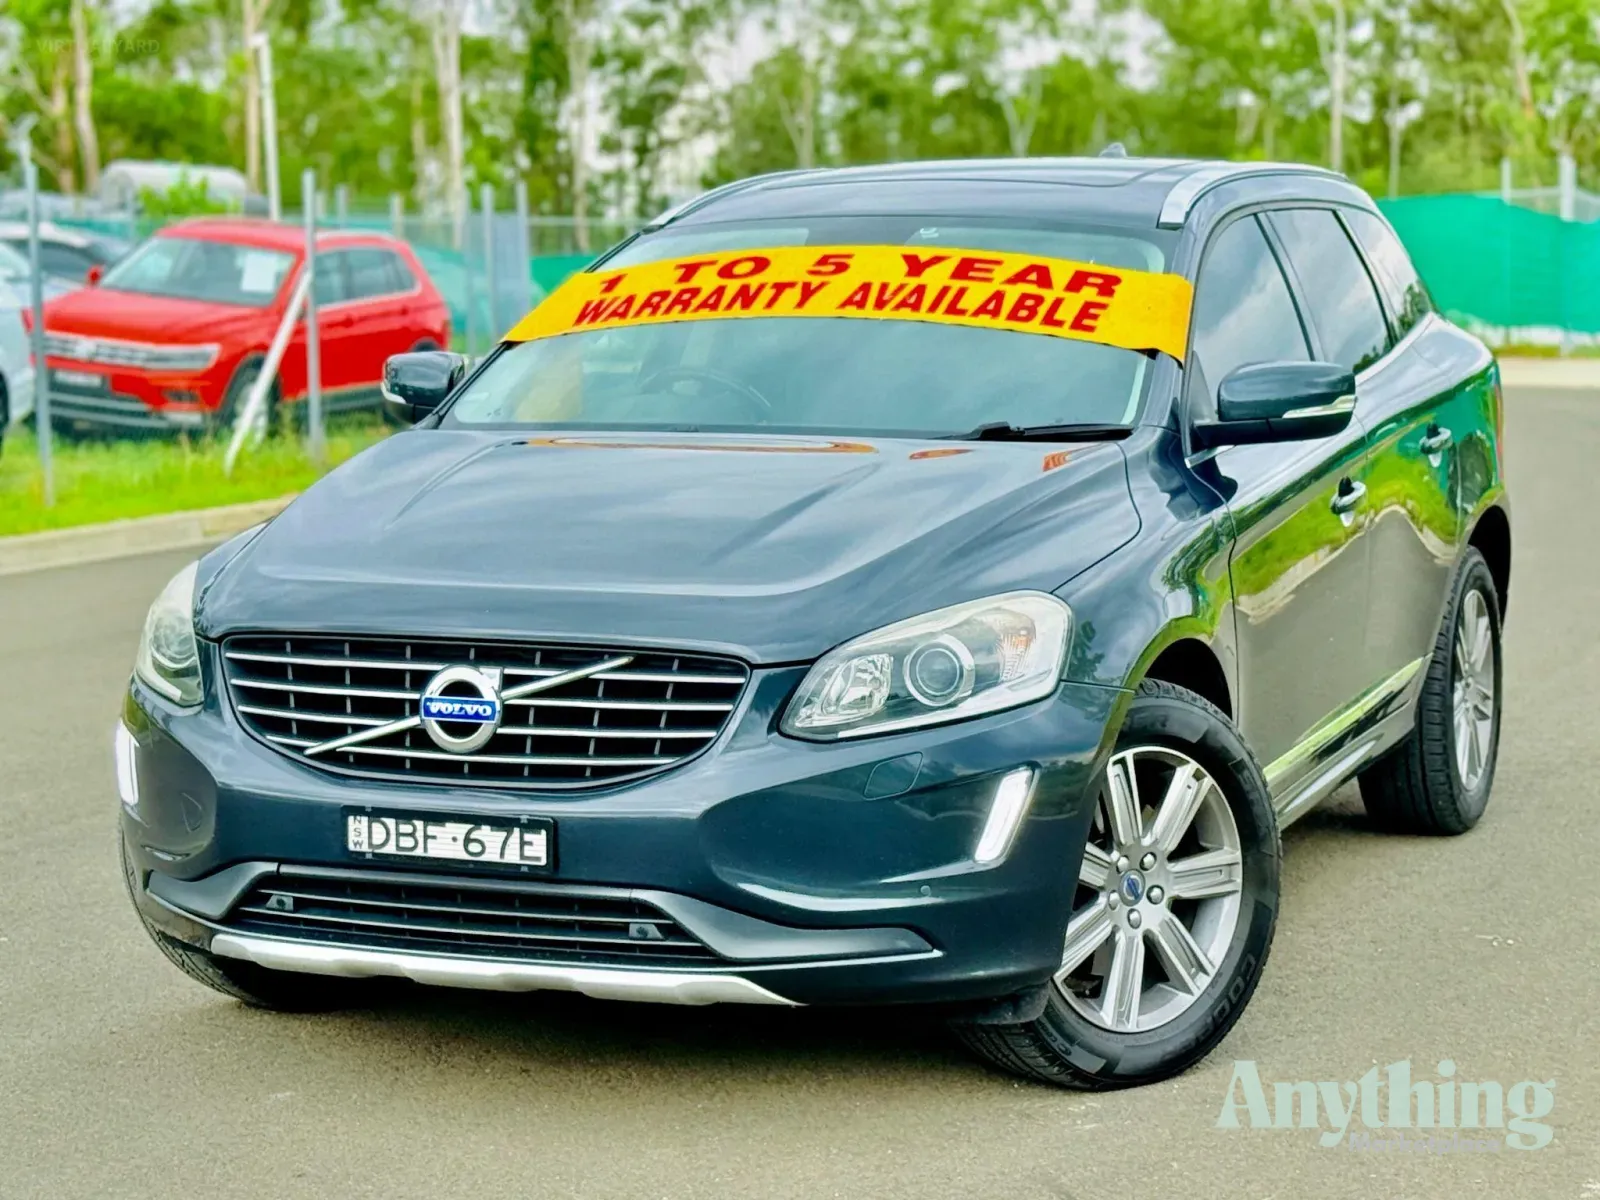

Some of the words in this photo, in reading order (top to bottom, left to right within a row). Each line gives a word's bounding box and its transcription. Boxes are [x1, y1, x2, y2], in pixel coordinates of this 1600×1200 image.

[600, 273, 628, 295] 1
[674, 256, 771, 285] TO
[807, 254, 854, 277] 5
[901, 253, 1122, 298] YEAR
[572, 281, 829, 327] WARRANTY
[836, 282, 1109, 333] AVAILABLE
[427, 702, 492, 717] VOLVO
